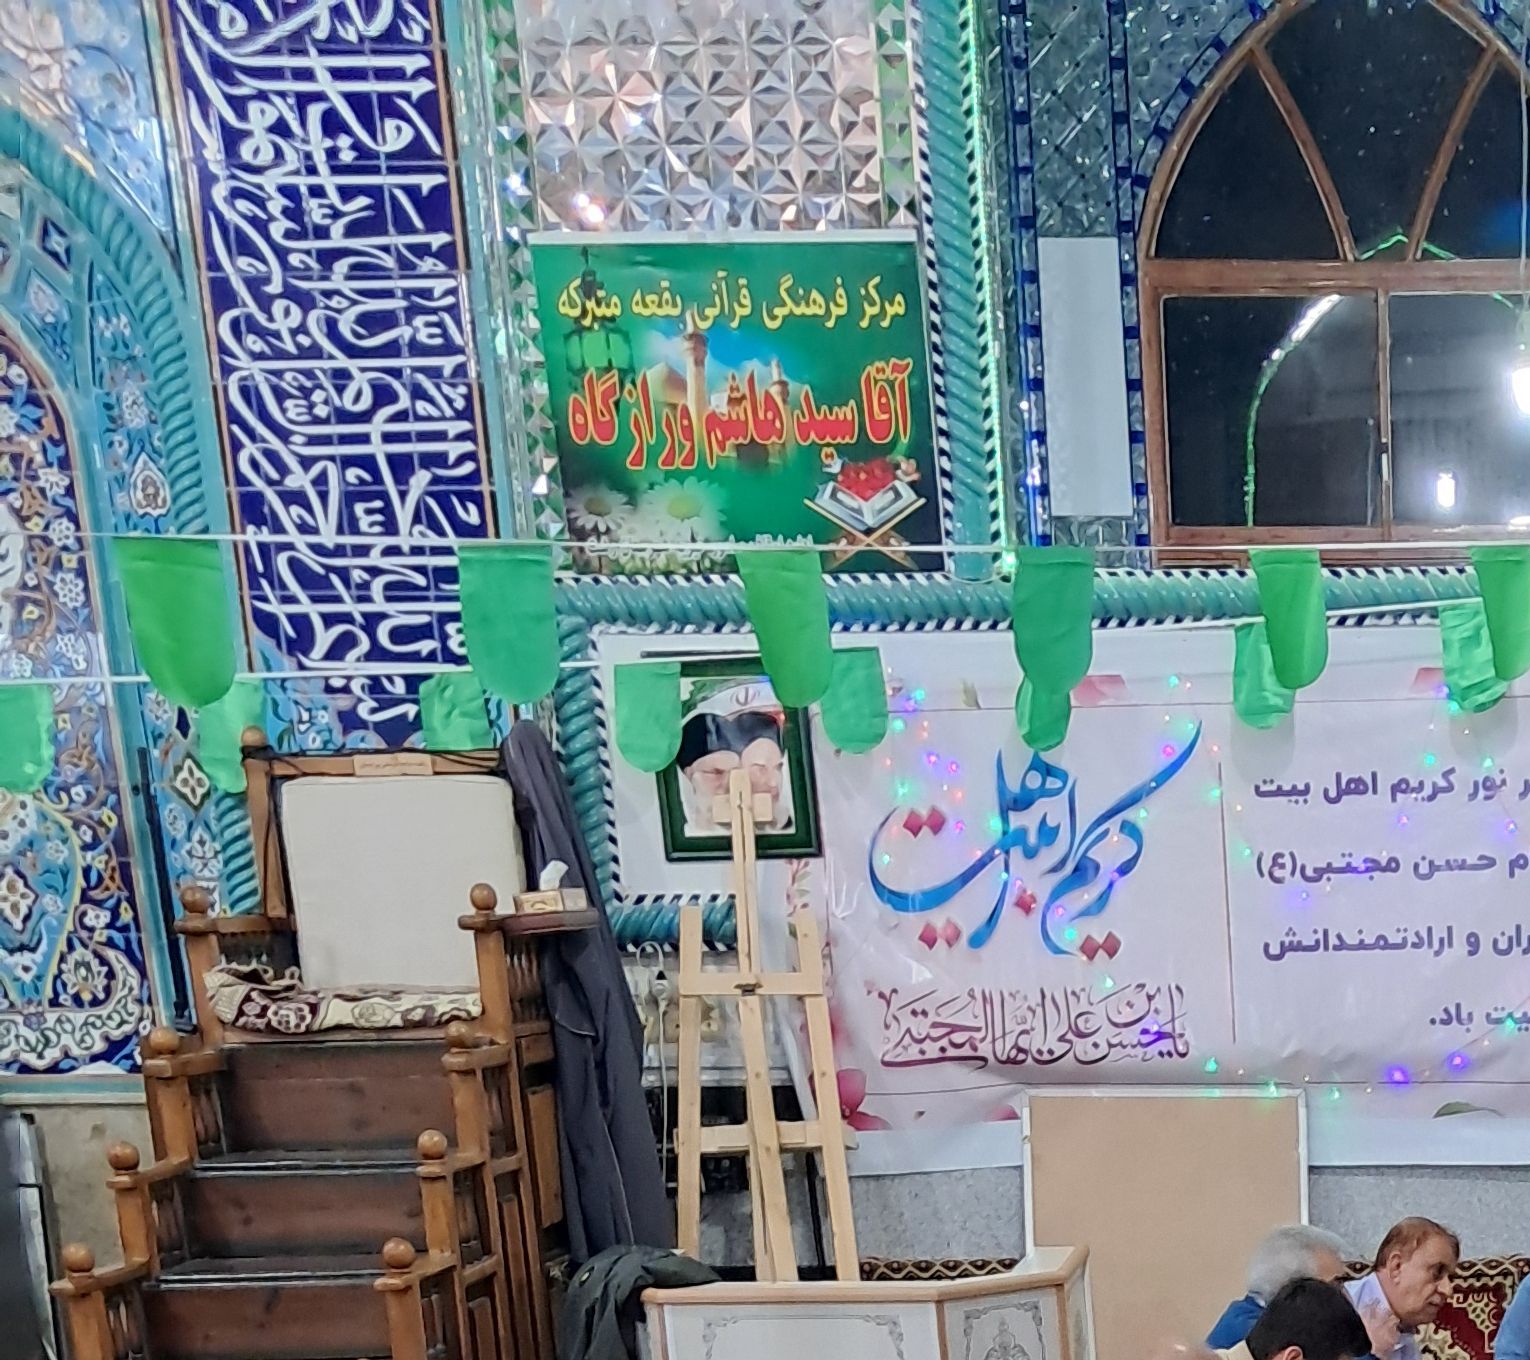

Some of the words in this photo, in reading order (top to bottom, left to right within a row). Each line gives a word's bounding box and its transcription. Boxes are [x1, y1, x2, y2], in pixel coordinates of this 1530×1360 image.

[559, 277, 621, 330] متبرکه
[631, 280, 682, 330] بقعه
[694, 270, 751, 329] قرآنی
[763, 274, 848, 329] فرهنگی
[859, 275, 905, 328] مرکز
[705, 370, 786, 469] هاشم
[794, 384, 858, 464] سید
[861, 358, 912, 443] آقا
[1254, 778, 1311, 804] بیت
[1323, 770, 1378, 804] اهل
[1390, 766, 1456, 802] کریم
[1467, 768, 1507, 801] نور
[1413, 853, 1497, 880] حسن
[1263, 925, 1454, 961] ارادتمندانش
[1465, 931, 1481, 957] و
